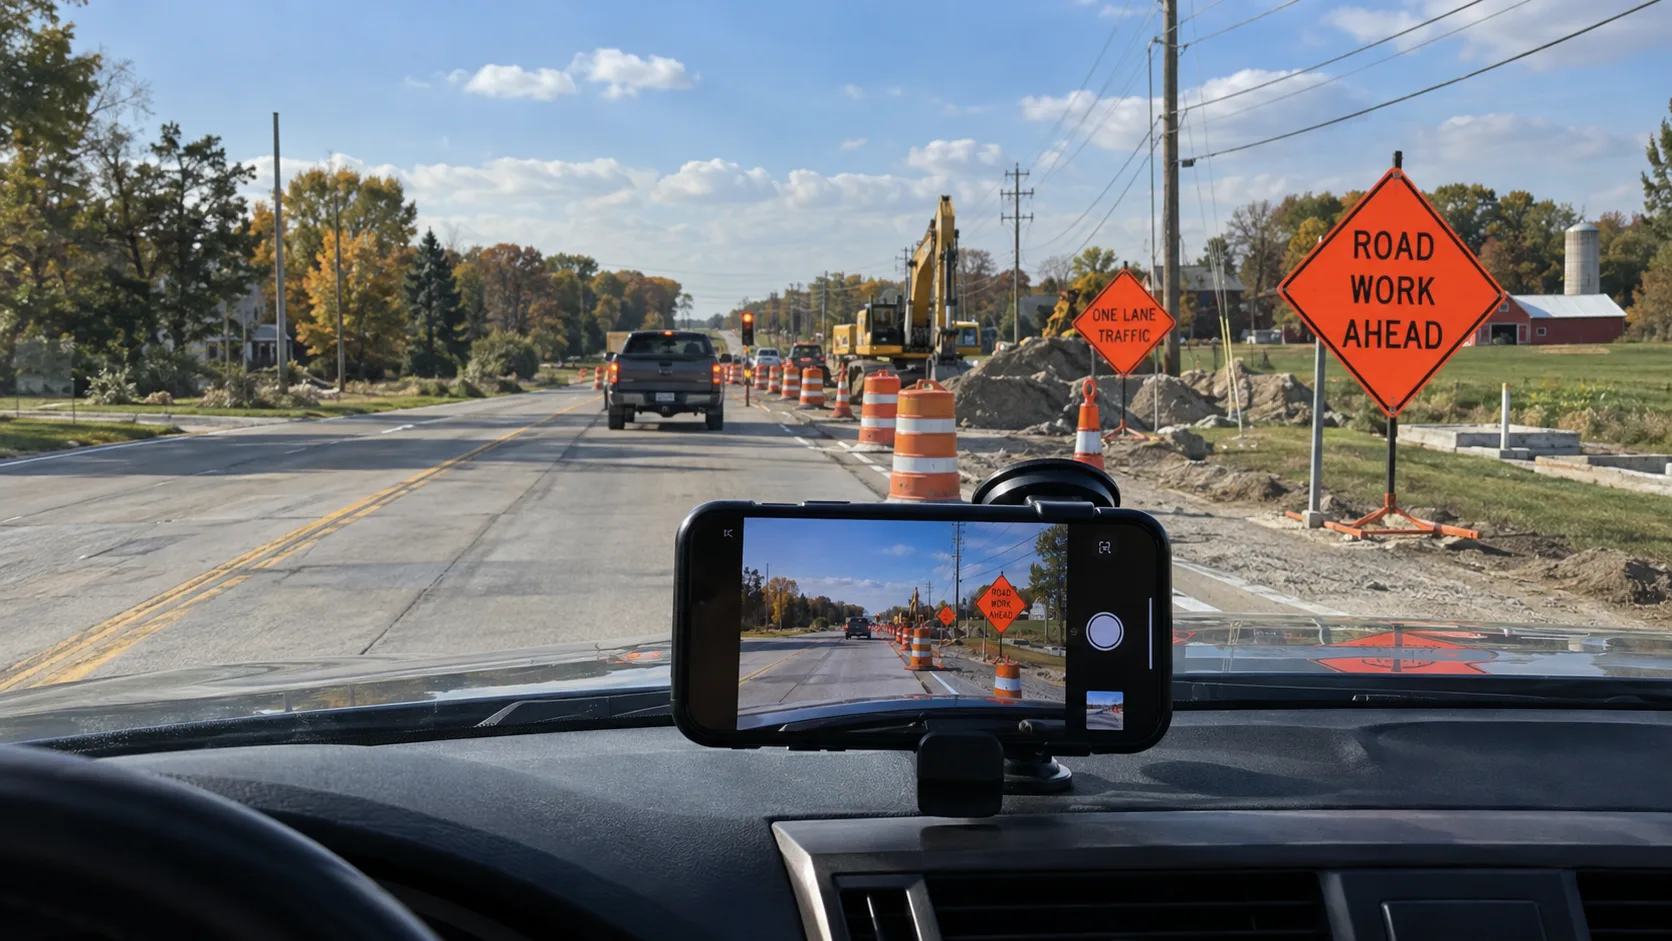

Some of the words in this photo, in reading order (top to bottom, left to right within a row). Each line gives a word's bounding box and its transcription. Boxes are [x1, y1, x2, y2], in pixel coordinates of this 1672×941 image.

[1354, 230, 1435, 261] ROAD
[1351, 275, 1435, 306] WORK
[1092, 308, 1118, 322] ONE
[1123, 307, 1156, 322] LANE
[1098, 329, 1151, 343] TRAFFIC
[1342, 319, 1443, 350] AHEAD
[991, 601, 1011, 609] WORK
[989, 611, 1013, 620] AHEAD
